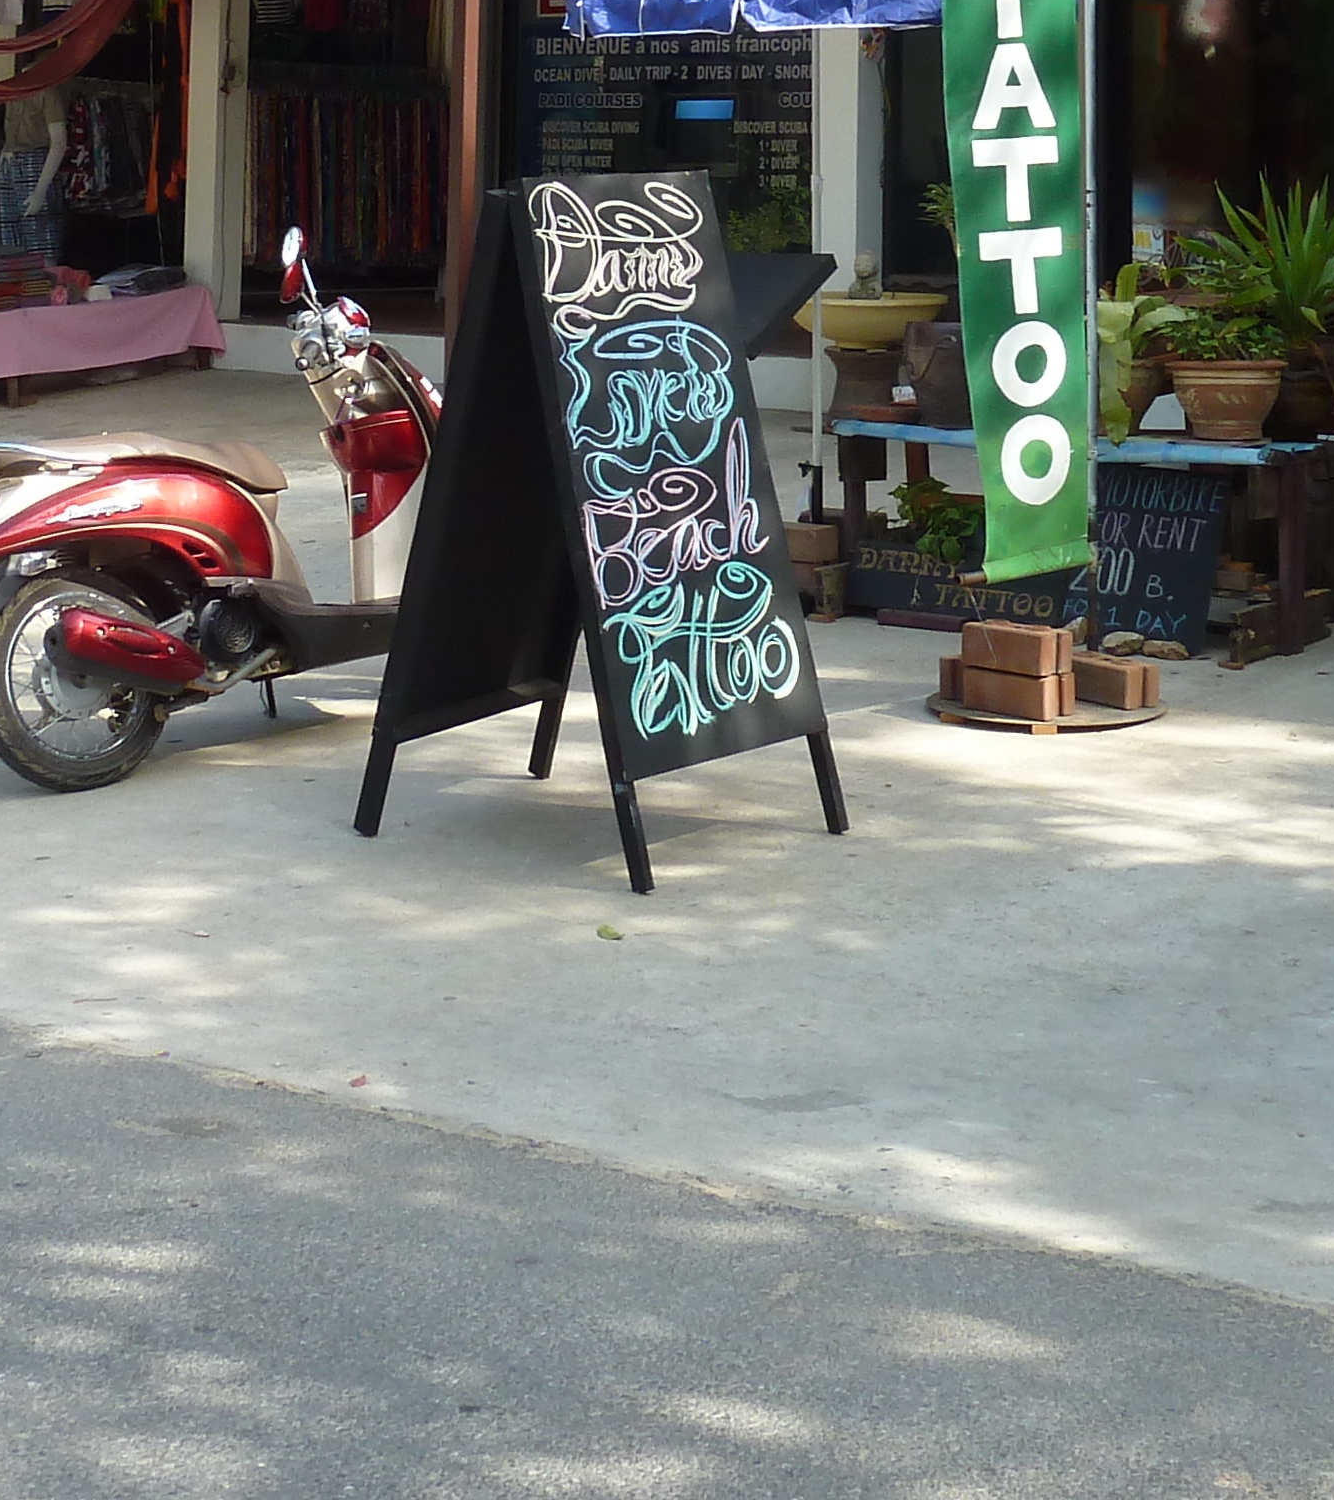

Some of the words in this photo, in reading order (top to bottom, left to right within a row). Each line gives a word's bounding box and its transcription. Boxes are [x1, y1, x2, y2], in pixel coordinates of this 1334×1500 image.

[536, 36, 631, 56] BIENVENUE
[651, 39, 680, 54] nos
[690, 36, 731, 54] amis
[534, 67, 571, 82] OCEAN
[610, 66, 642, 81] DAILY
[645, 66, 672, 80] TRIP
[681, 65, 689, 80] 2
[696, 65, 732, 81] DIVES
[742, 65, 764, 80] DAY
[539, 93, 571, 108] PADI
[575, 92, 643, 108] COURSES
[543, 121, 582, 134] DISCOVER
[583, 121, 610, 134] SCUBA
[733, 121, 776, 134] DISCOVER
[779, 121, 808, 134] SCUBA
[590, 138, 614, 150] DIVER
[771, 139, 798, 151] DIVER
[771, 156, 798, 169] DIVER
[582, 417, 770, 609] Beach
[1138, 511, 1207, 552] RENT
[857, 547, 964, 579] DANNY
[935, 583, 1054, 619] TATTOO
[1105, 607, 1120, 626] 1
[1136, 610, 1186, 637] DAY
